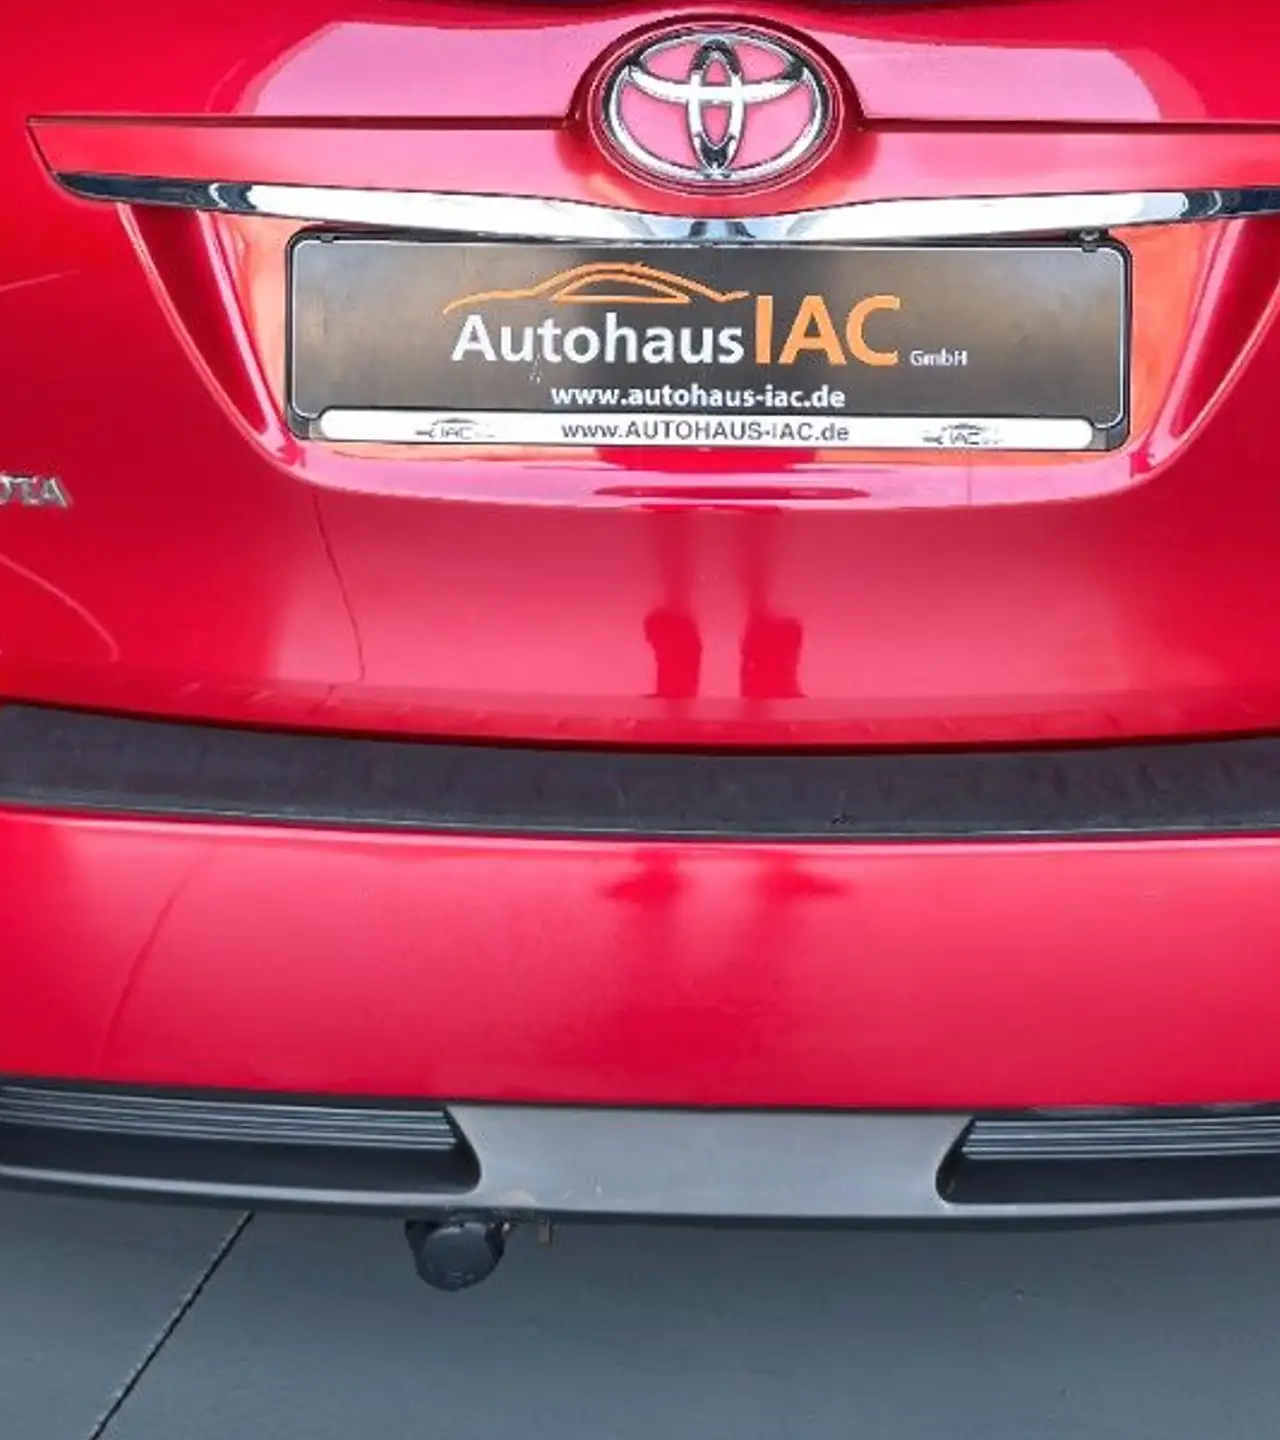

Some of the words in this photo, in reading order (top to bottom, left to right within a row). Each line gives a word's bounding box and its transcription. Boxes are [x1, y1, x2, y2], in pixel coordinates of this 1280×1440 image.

[451, 311, 744, 364] Autohaus
[755, 294, 902, 366] IAC
[910, 348, 968, 366] GmbH
[550, 382, 847, 408] www.autohaus-iac.de
[561, 419, 850, 442] www.AUTOHAUS-IAC.de
